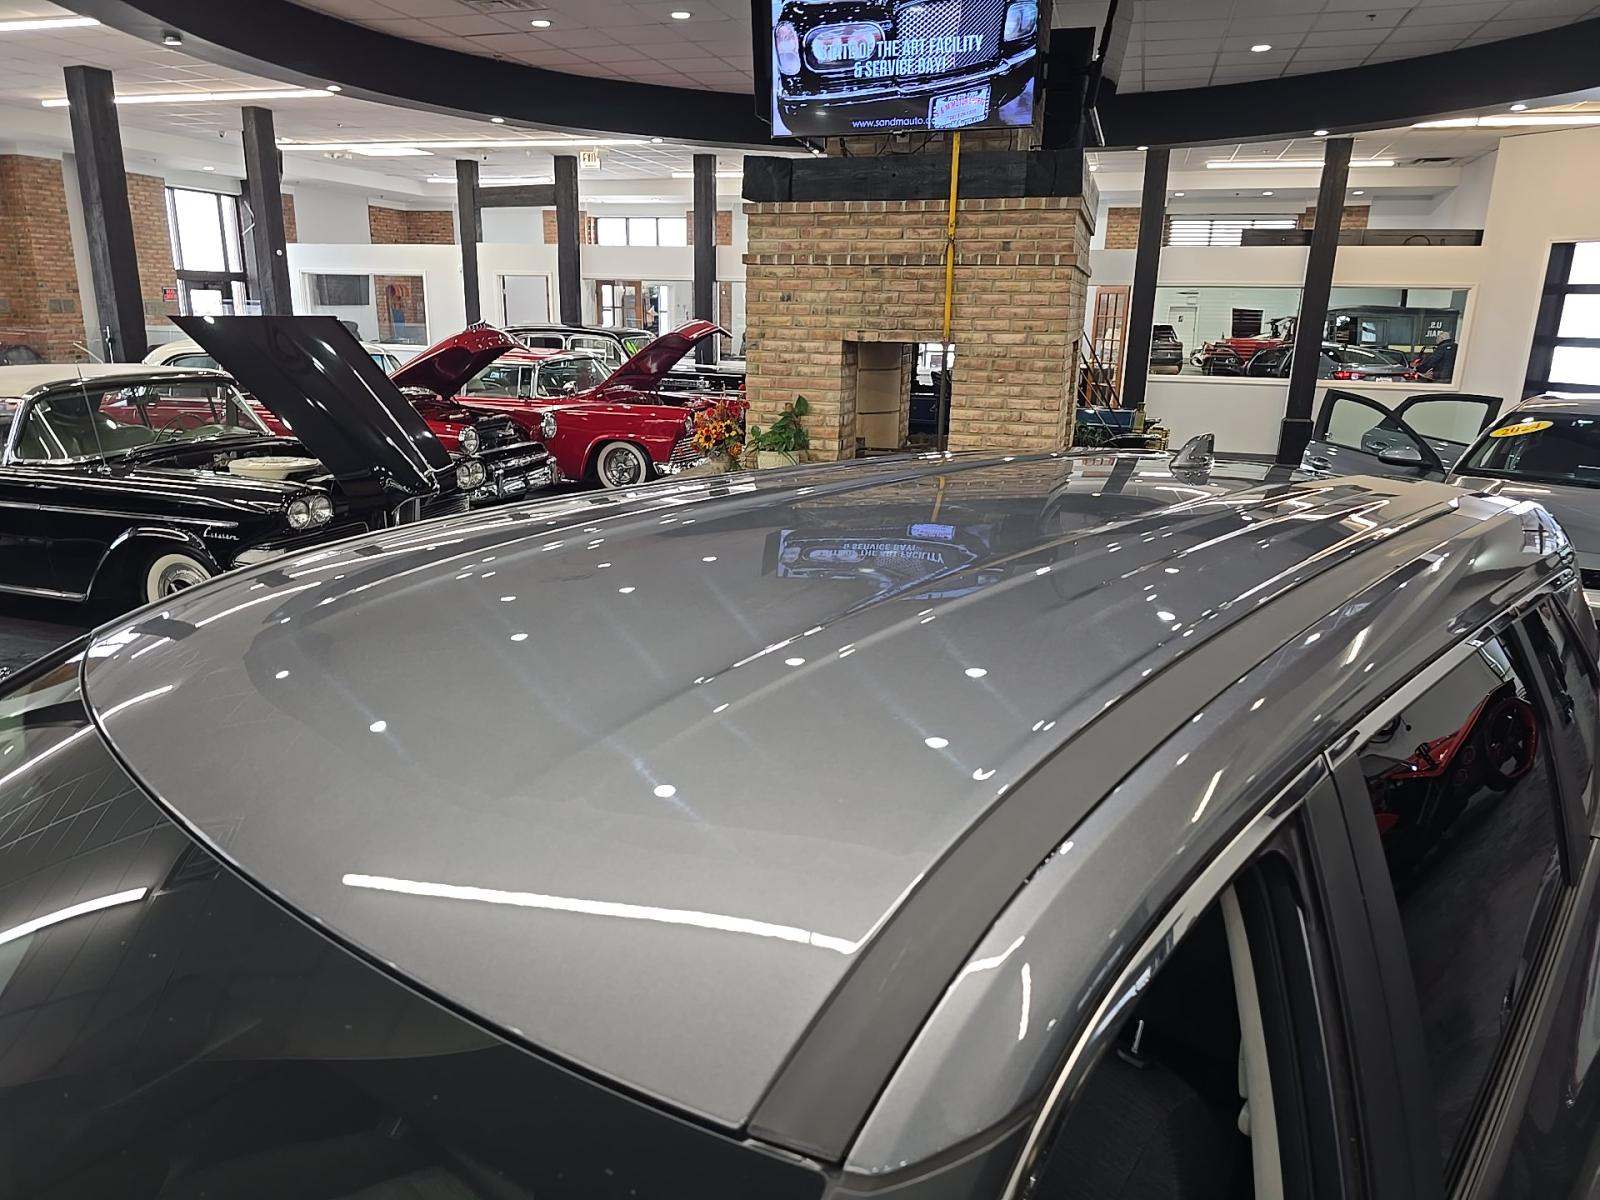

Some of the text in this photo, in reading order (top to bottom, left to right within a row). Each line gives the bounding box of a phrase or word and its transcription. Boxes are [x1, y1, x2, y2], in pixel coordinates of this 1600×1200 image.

[876, 39, 900, 58] THE
[928, 34, 984, 54] FACILITY
[853, 61, 863, 78] &
[865, 57, 915, 77] SERVICE
